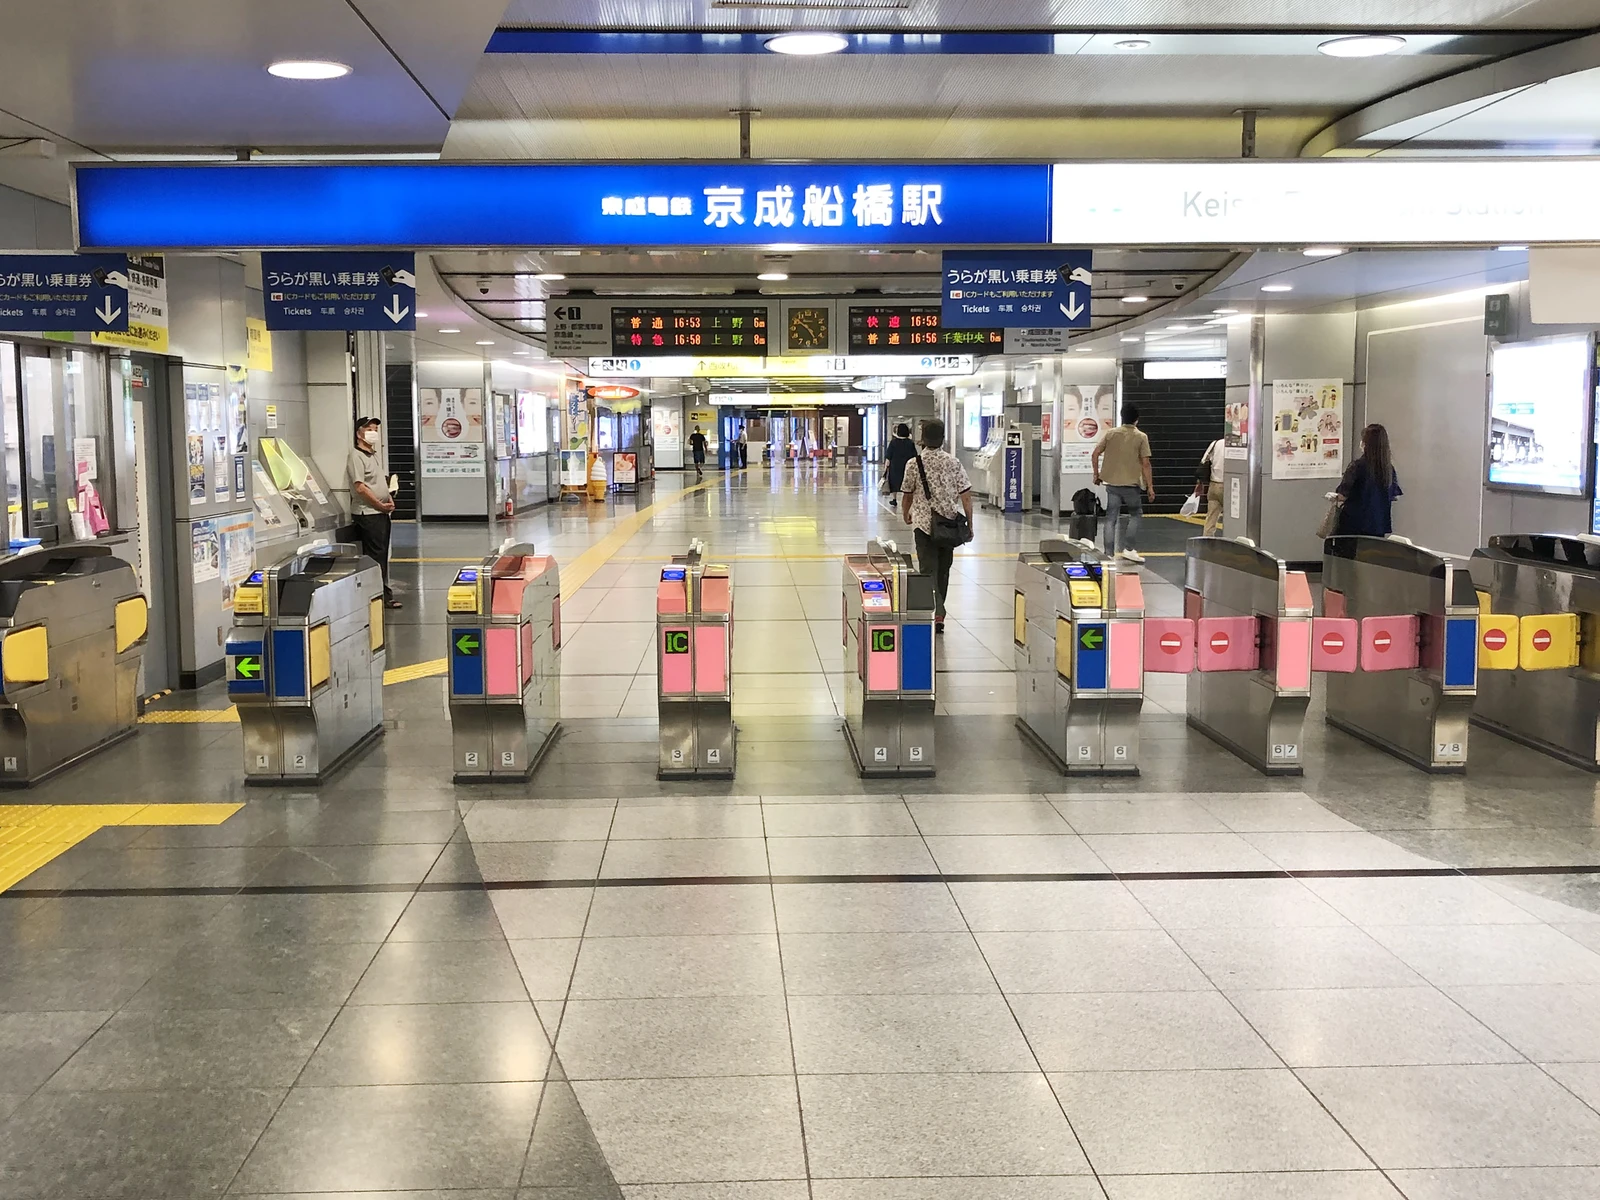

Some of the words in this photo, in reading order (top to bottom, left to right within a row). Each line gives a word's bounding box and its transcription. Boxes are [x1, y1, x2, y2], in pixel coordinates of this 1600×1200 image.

[703, 184, 943, 228] 京成船橋駅
[267, 271, 380, 286] うらが黒い乗車券
[947, 269, 1058, 285] うらが黒い乗車券
[284, 293, 377, 301] ICカードもご利用いただけます
[963, 290, 1054, 298] ICカードもご利用いただけます
[55, 308, 76, 317] 승차권
[283, 307, 312, 316] Tickets
[344, 307, 365, 316] 승차권
[961, 304, 990, 313] Tickets
[1021, 304, 1042, 313] 승차권
[630, 317, 664, 329] 普通
[674, 317, 701, 328] 16:53
[711, 317, 743, 329] 上野
[867, 316, 900, 328] 快速
[911, 316, 938, 327] 16:53
[630, 334, 664, 345] 特急
[674, 334, 701, 345] 16:58
[711, 334, 743, 345] 上野
[867, 333, 900, 345] 普通
[911, 333, 937, 344] 16:56
[942, 332, 985, 344] 千葉中央
[666, 632, 688, 652] IC
[872, 631, 894, 651] IC
[877, 748, 884, 756] 4
[912, 748, 920, 756] 5
[1081, 746, 1088, 755] 5
[1116, 746, 1124, 755] 6
[1274, 745, 1282, 754] 6
[1287, 745, 1295, 753] 7
[1439, 744, 1447, 752] 7
[1452, 744, 1460, 752] 8
[468, 753, 476, 762] 2
[504, 753, 512, 761] 3
[674, 750, 682, 758] 3
[7, 757, 13, 765] 1
[259, 756, 265, 764] 1
[296, 755, 304, 764] 2
